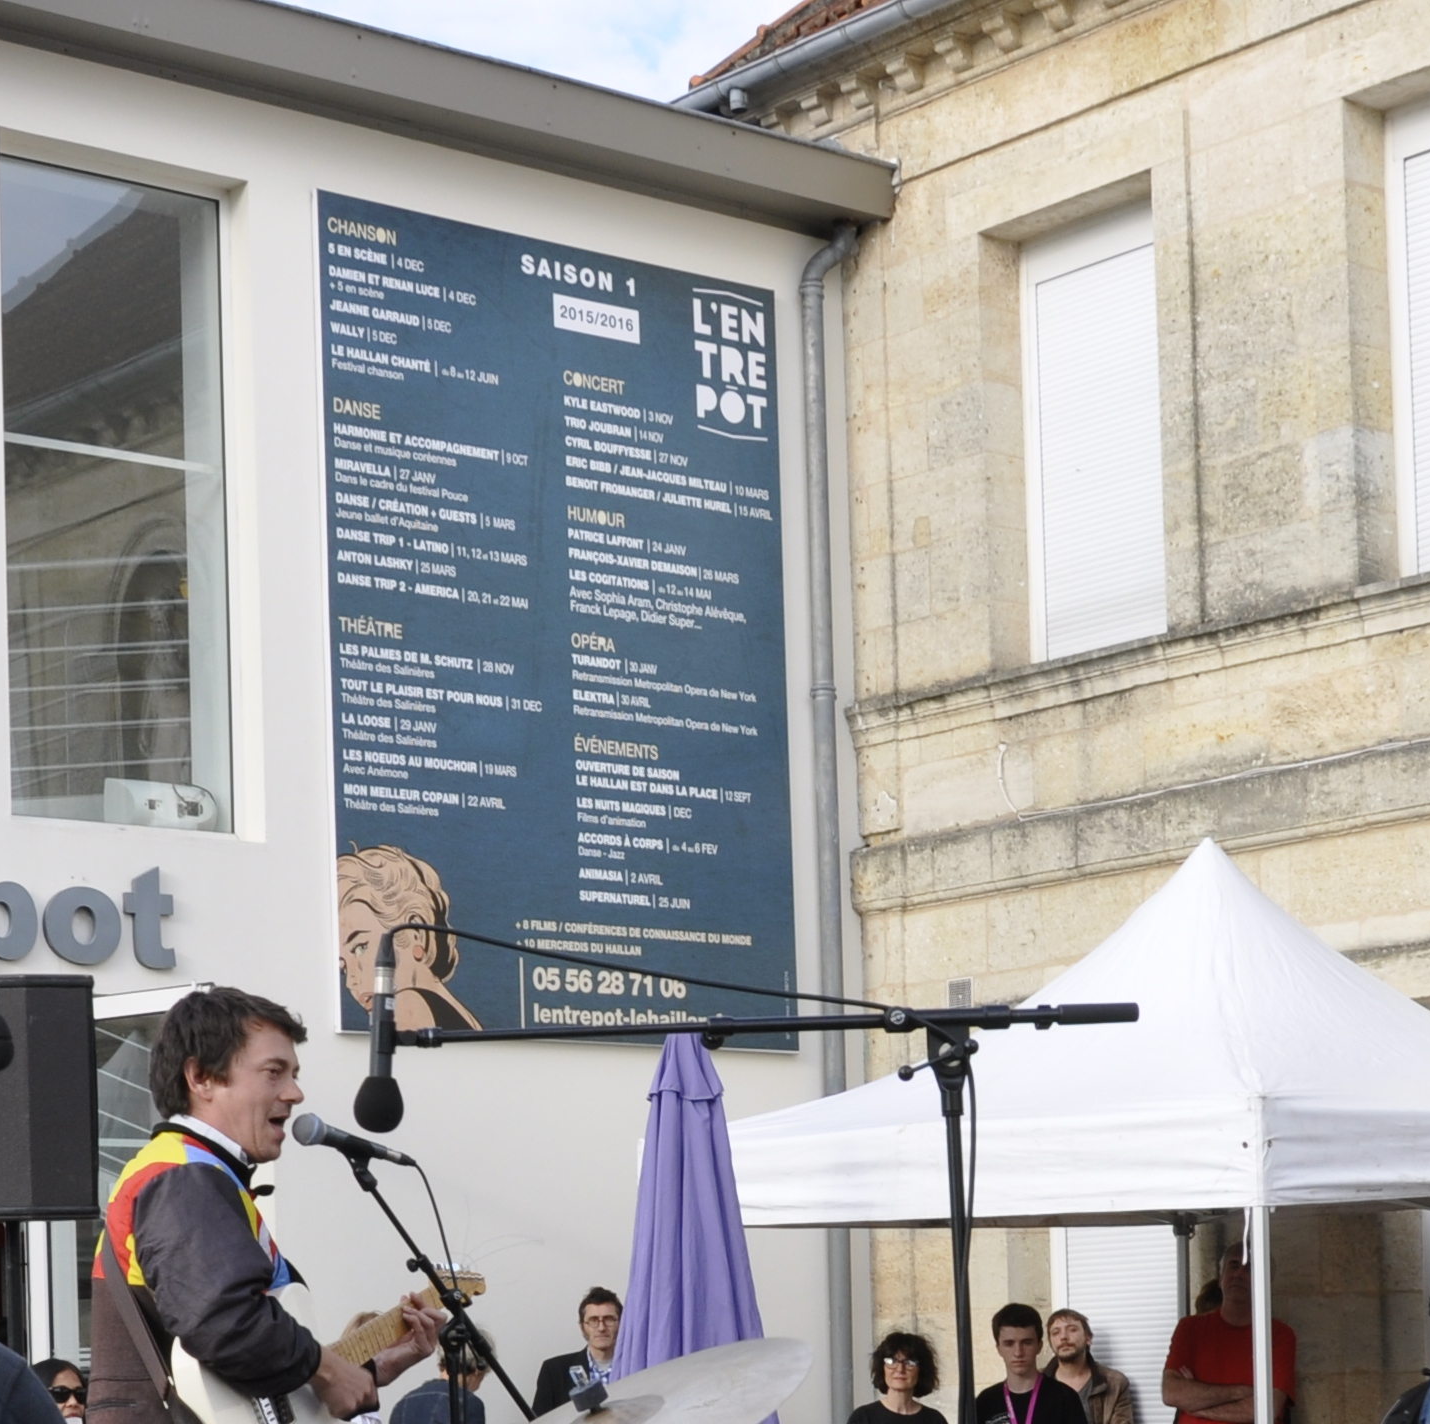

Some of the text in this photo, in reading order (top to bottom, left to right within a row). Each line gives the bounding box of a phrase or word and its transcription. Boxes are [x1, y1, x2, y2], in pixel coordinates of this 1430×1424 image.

[327, 216, 396, 246] CHANSON
[328, 242, 424, 273] 5 EN SCÈNE 4 DEC
[328, 264, 475, 305] DAMIEN ET RENAN LUCE 4 DEC
[521, 253, 635, 296] SAISON 1
[345, 284, 356, 294] en
[358, 283, 384, 300] scène
[329, 298, 452, 333] JEANNE GARRAUD 5 DEC
[560, 304, 633, 332] 2015/2016
[692, 298, 764, 347] L'EN
[330, 321, 397, 345] WALLY 5 DEC
[331, 357, 404, 381] Festival chanson
[694, 339, 766, 390] TRE
[563, 369, 624, 395] CONCERT
[333, 396, 380, 420] DANSE
[564, 395, 673, 425] KYLE EASTWOOD 3 NOV
[695, 378, 767, 430] PÔT
[333, 422, 528, 466] HARMONIE ET ACCOMPAGNEMENT 9 OCT
[334, 457, 436, 484] MIRAVELLA 27 JANV
[335, 491, 515, 530] DANSE CRÉATION GUESTS 5 MARS
[568, 505, 624, 528] HUMOUR
[567, 527, 604, 544] PATRICE
[606, 533, 643, 550] LAFFONT
[663, 543, 686, 556] JANV
[337, 549, 371, 565] ANTON
[374, 554, 413, 571] LASHKY
[431, 563, 456, 577] MARS
[568, 547, 649, 572] FRANÇOIS-XAVIER
[650, 560, 697, 578] DEMAISON
[714, 570, 738, 584] MARS
[338, 612, 402, 639] THÉÂTRE
[571, 629, 615, 653] OPÉRA
[339, 642, 514, 675] LES PALMES DE M. SCHUTZ 28 NOV
[571, 653, 621, 670] TURANDOT
[638, 662, 657, 675] JANV
[342, 712, 436, 733] LA LOOSE 29 JANV
[574, 732, 658, 760] ÉVÉNEMENTS
[343, 748, 516, 777] LES NOEUDS AU MOUCHOIR 19 MARS
[575, 759, 679, 780] OUVERTURE DE SAISON
[344, 783, 505, 809] MON MEILLEUR COPAIN 22 AVRIL
[576, 774, 751, 803] LE HAILLAN EST DANS LA PLACE 12 SEPT
[576, 796, 691, 818] LES NUITS MAGIQUES DEC
[578, 867, 662, 885] ANIMASIA 2 AVRIL
[579, 890, 690, 909] SUPERNATUREL 25 JUIN
[532, 965, 687, 999] 05 56 28 71 06
